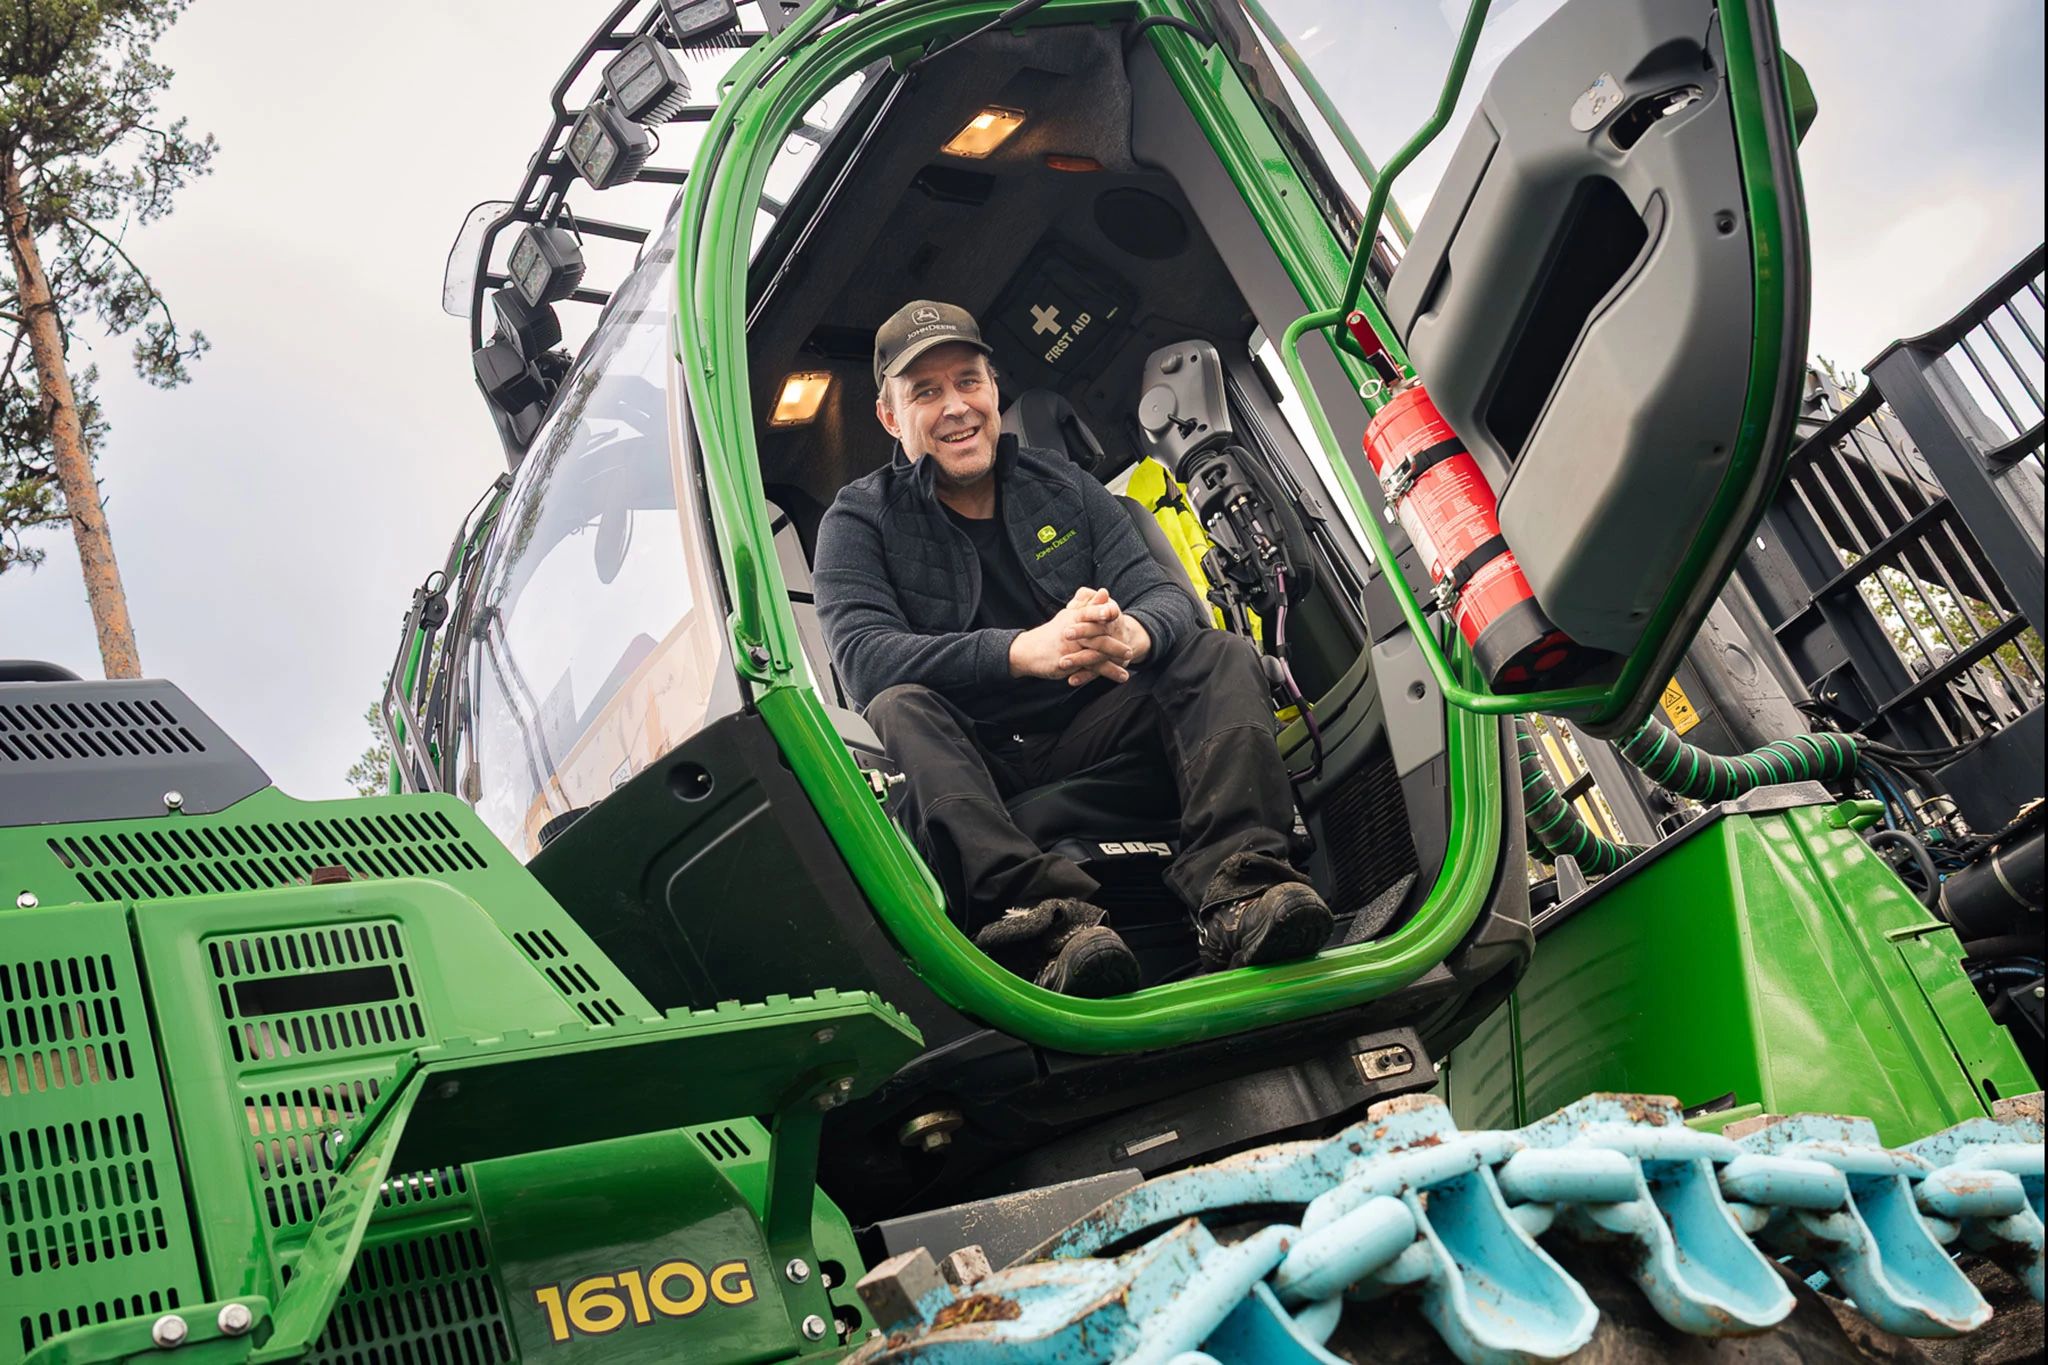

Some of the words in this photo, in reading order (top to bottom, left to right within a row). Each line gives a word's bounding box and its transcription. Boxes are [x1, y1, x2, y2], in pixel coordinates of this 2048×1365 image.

[1044, 332, 1073, 364] FIRST
[1071, 312, 1091, 335] AID
[533, 1260, 756, 1344] 1610G
